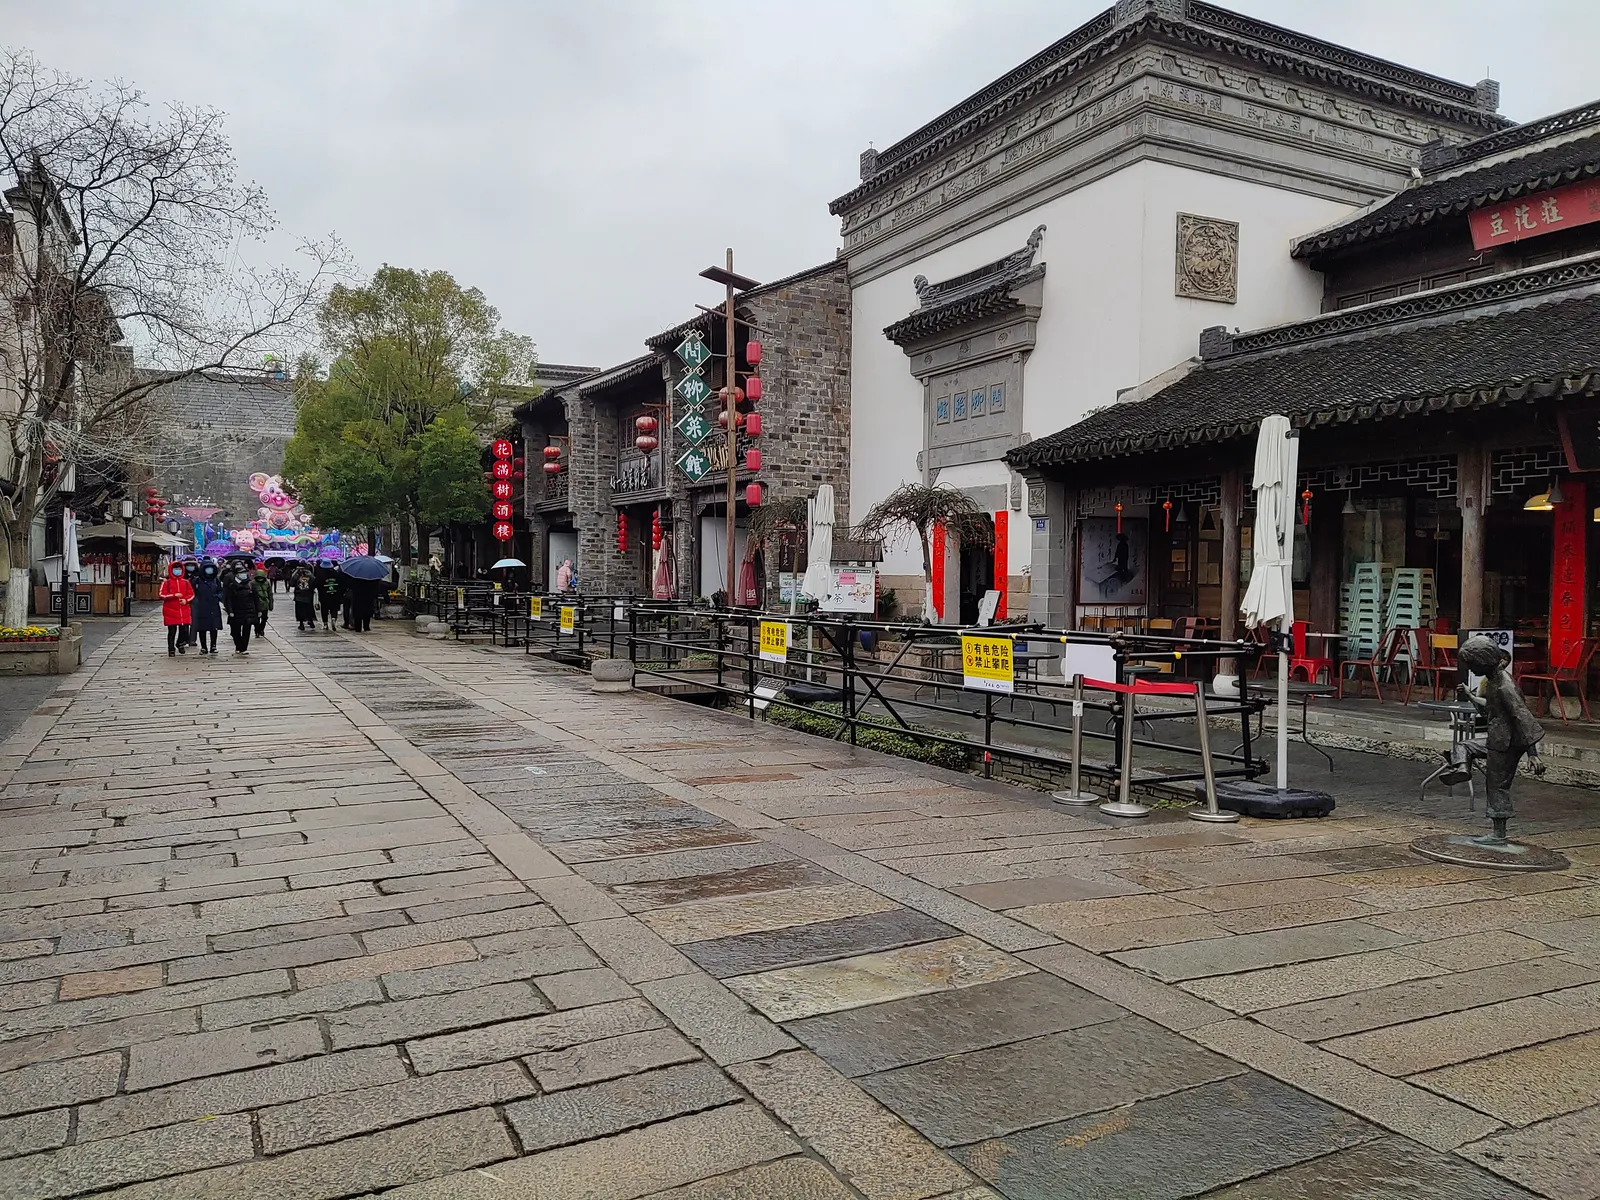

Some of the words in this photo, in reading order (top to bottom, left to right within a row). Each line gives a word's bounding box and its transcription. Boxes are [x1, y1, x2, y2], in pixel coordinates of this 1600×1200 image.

[683, 341, 704, 476] 問柳菜館
[974, 643, 1009, 657] 有电危险
[974, 656, 1010, 671] 禁止攀爬
